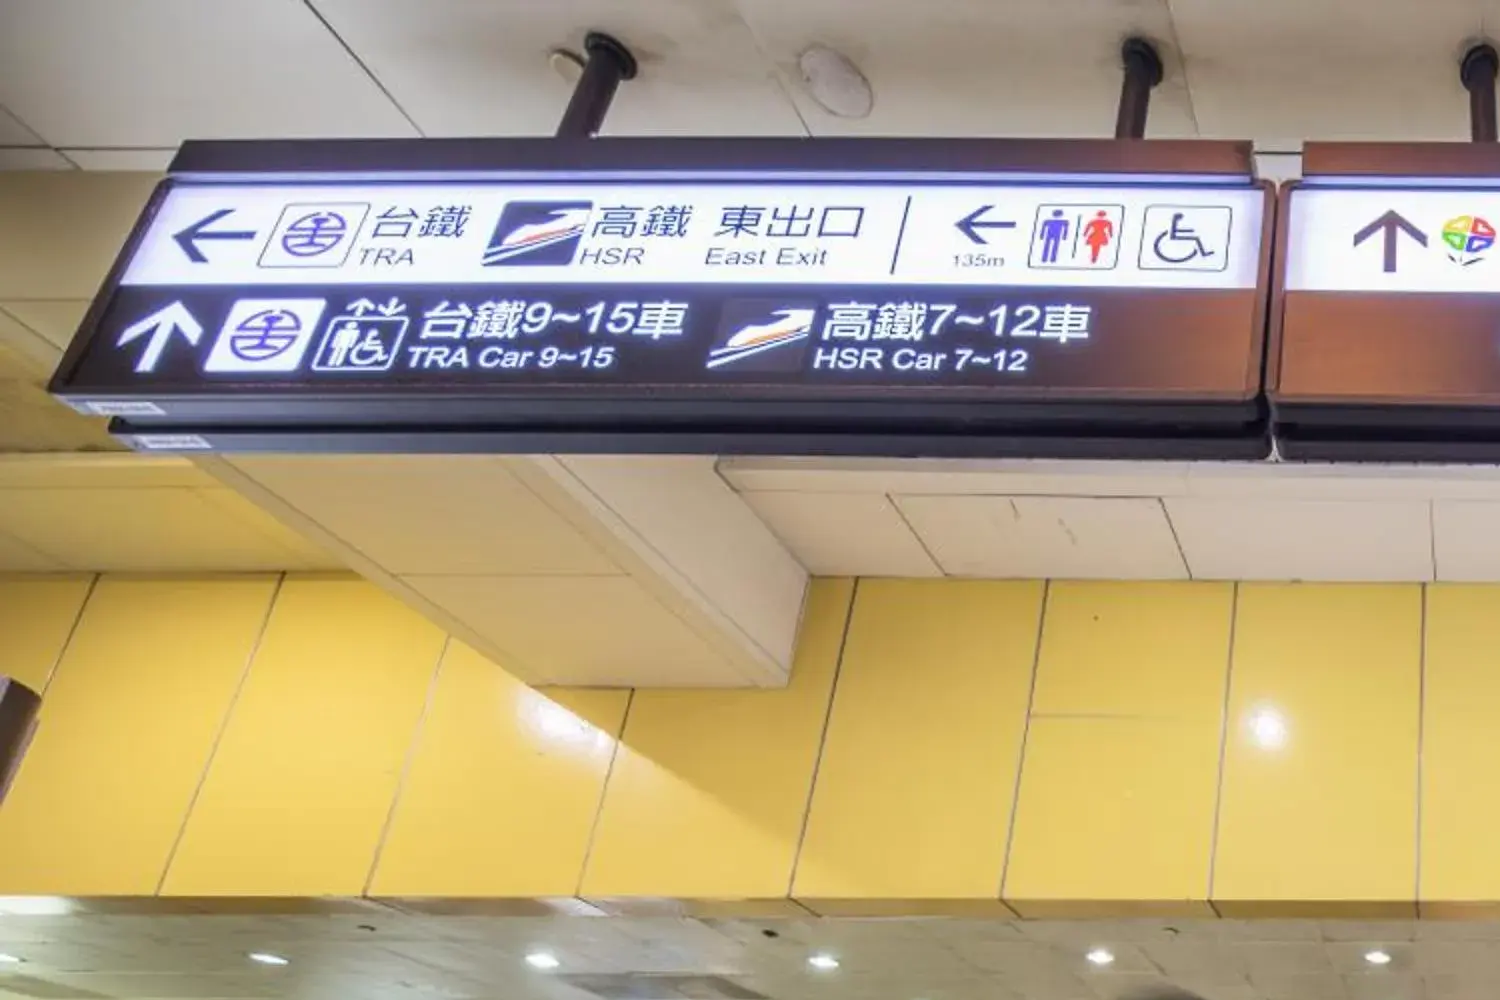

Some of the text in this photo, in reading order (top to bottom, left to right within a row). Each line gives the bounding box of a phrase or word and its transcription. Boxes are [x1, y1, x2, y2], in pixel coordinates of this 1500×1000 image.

[372, 204, 472, 239] 台鐵
[591, 204, 694, 239] 高鐵
[713, 205, 867, 240] 東出口
[358, 247, 416, 266] TRA
[580, 247, 646, 266] HSR
[704, 246, 828, 267] East Exit
[953, 253, 1006, 268] 135m
[419, 300, 689, 341] 台鐵9~15車
[821, 301, 1092, 343] 高鐵7~12車
[407, 346, 616, 369] TRA Car 9~15
[813, 348, 1028, 373] HSR Car 7~12
